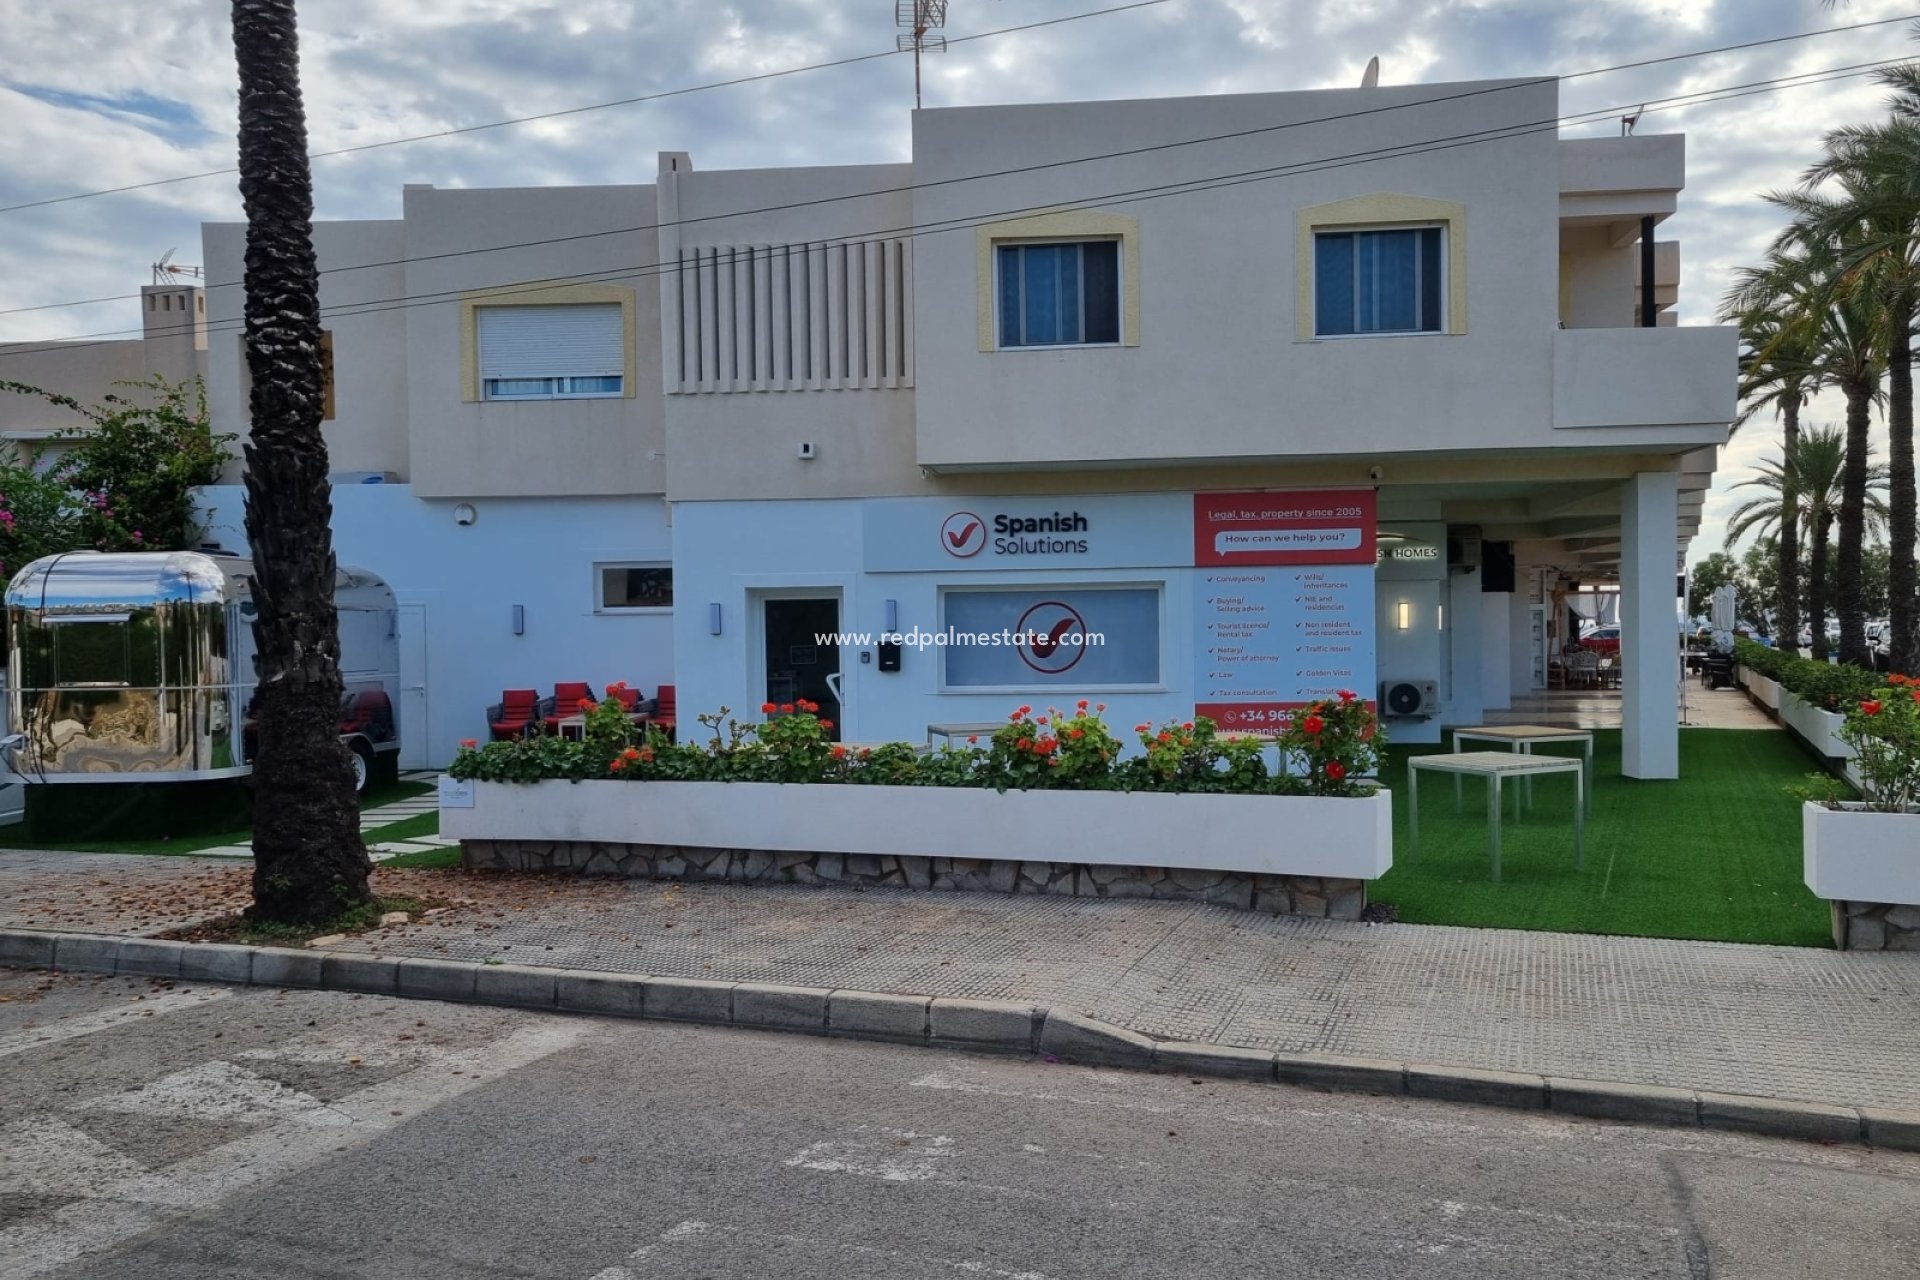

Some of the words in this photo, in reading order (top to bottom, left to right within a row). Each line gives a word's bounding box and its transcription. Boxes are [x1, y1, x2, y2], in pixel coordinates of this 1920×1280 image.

[1208, 510, 1237, 521] Legal,
[1261, 509, 1304, 520] property
[1306, 508, 1333, 518] since
[1336, 507, 1362, 517] 2005
[994, 511, 1088, 538] Spanish
[1225, 535, 1250, 543] How
[1274, 535, 1290, 543] we
[1292, 533, 1317, 544] help
[1318, 532, 1345, 544] you?
[994, 536, 1088, 555] Solutions
[1395, 548, 1438, 558] HOMES
[1216, 575, 1266, 583] Conveyancing
[1216, 596, 1245, 605] Buying/
[1216, 605, 1241, 613] Selling
[1242, 604, 1265, 612] advice
[1217, 622, 1241, 630] Tourist
[1321, 620, 1351, 628] resident
[1217, 645, 1244, 654] Notary/
[1249, 654, 1280, 663] attorney
[1232, 688, 1278, 696] consultation
[1239, 710, 1266, 721] +34
